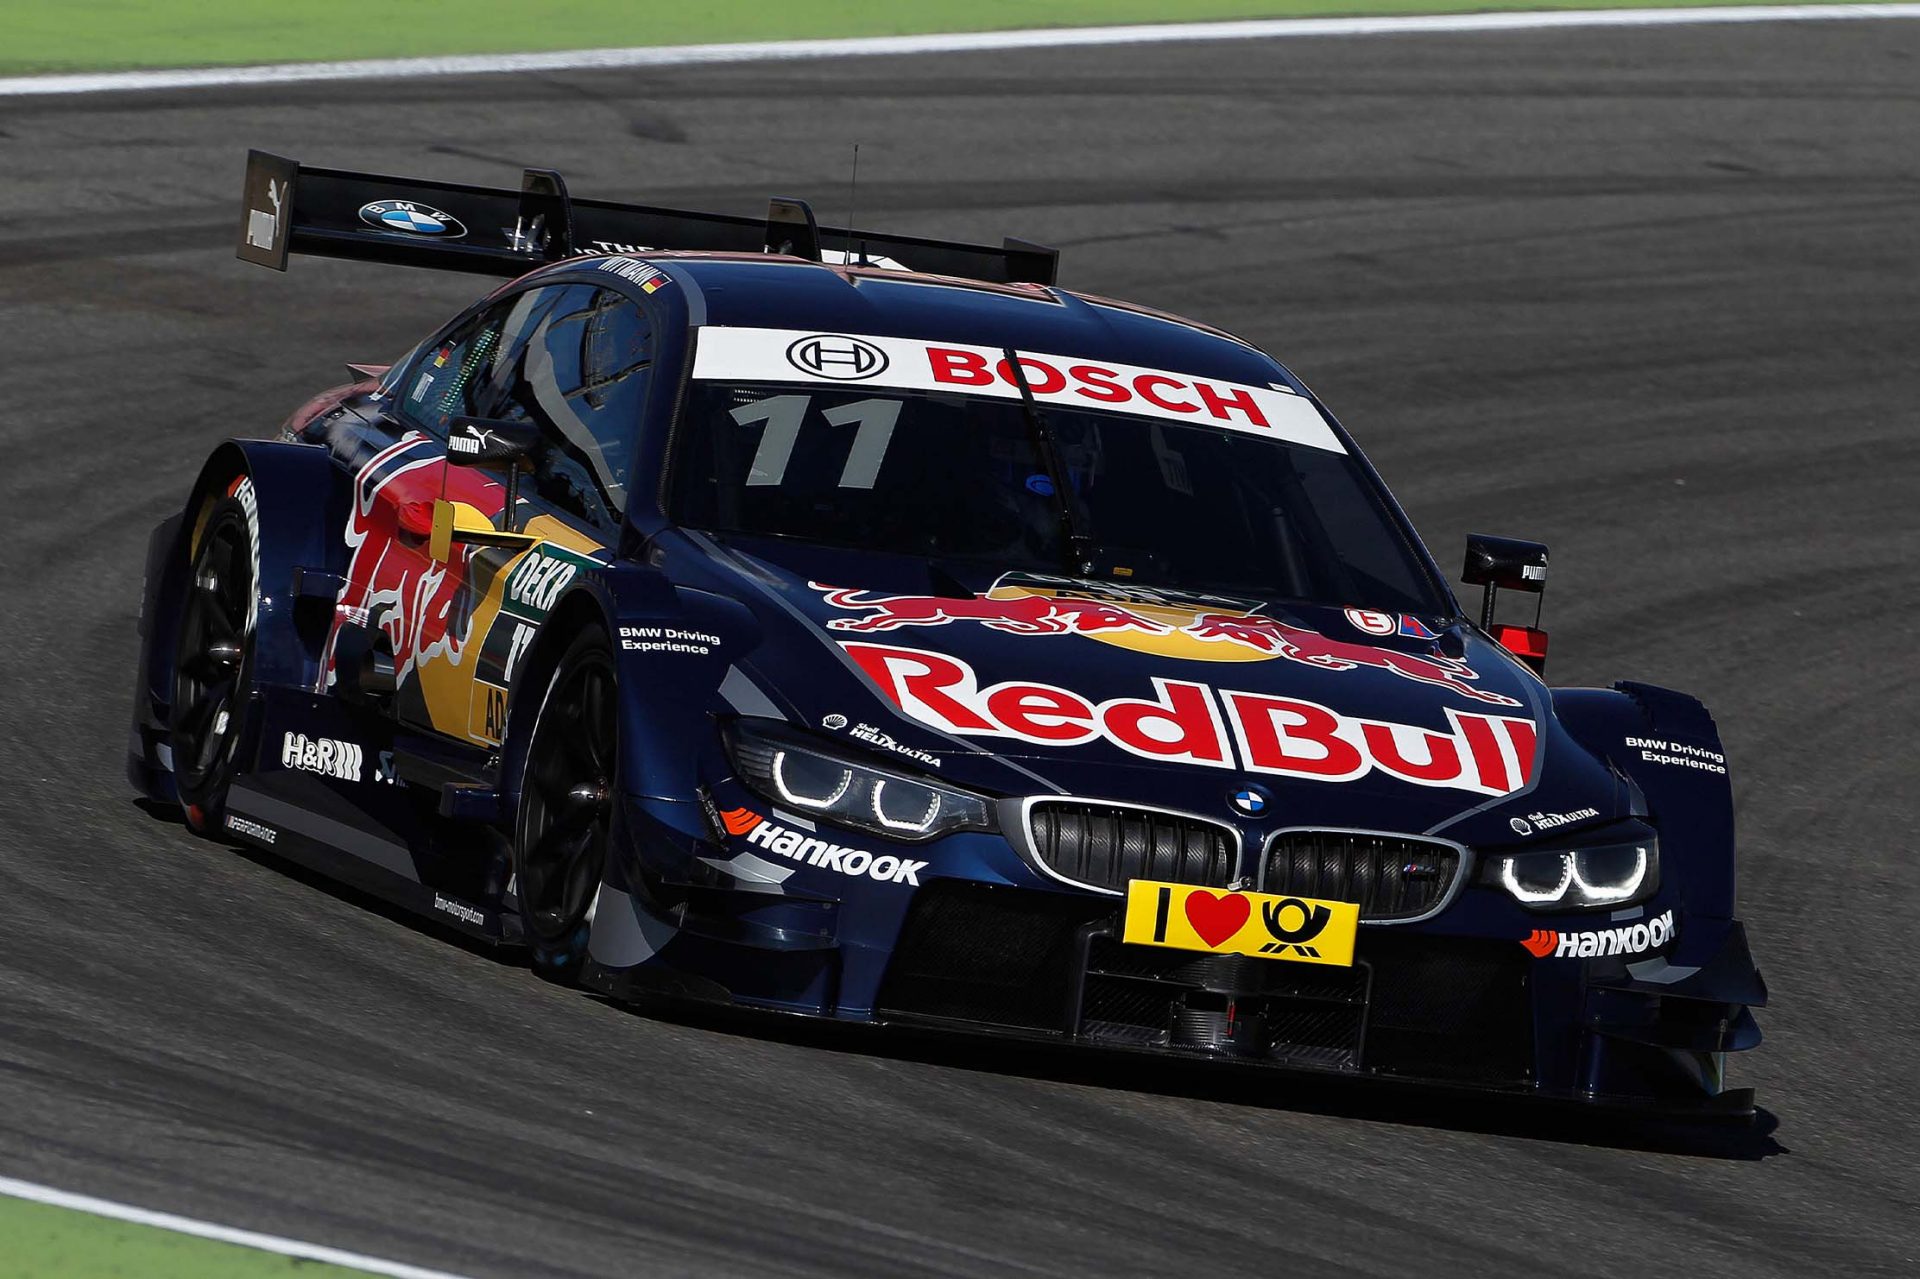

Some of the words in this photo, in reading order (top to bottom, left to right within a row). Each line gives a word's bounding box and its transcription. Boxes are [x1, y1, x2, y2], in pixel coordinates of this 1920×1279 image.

[366, 202, 451, 221] BMW
[925, 347, 1271, 428] BOSCH
[728, 394, 904, 488] 11
[619, 627, 661, 638] BMW
[665, 628, 721, 646] Driving
[621, 639, 709, 655] Experience
[837, 641, 1238, 770] Red
[1220, 688, 1538, 797] Bull
[857, 722, 880, 733] Shell
[282, 731, 338, 776] H&R
[849, 727, 898, 752] HELIX
[896, 745, 941, 767] ULTRA
[1625, 737, 1667, 750] BMW
[1670, 742, 1724, 763] Driving
[1641, 750, 1726, 774] Experience
[1565, 807, 1600, 822] ULTRA
[1153, 887, 1172, 943] I
